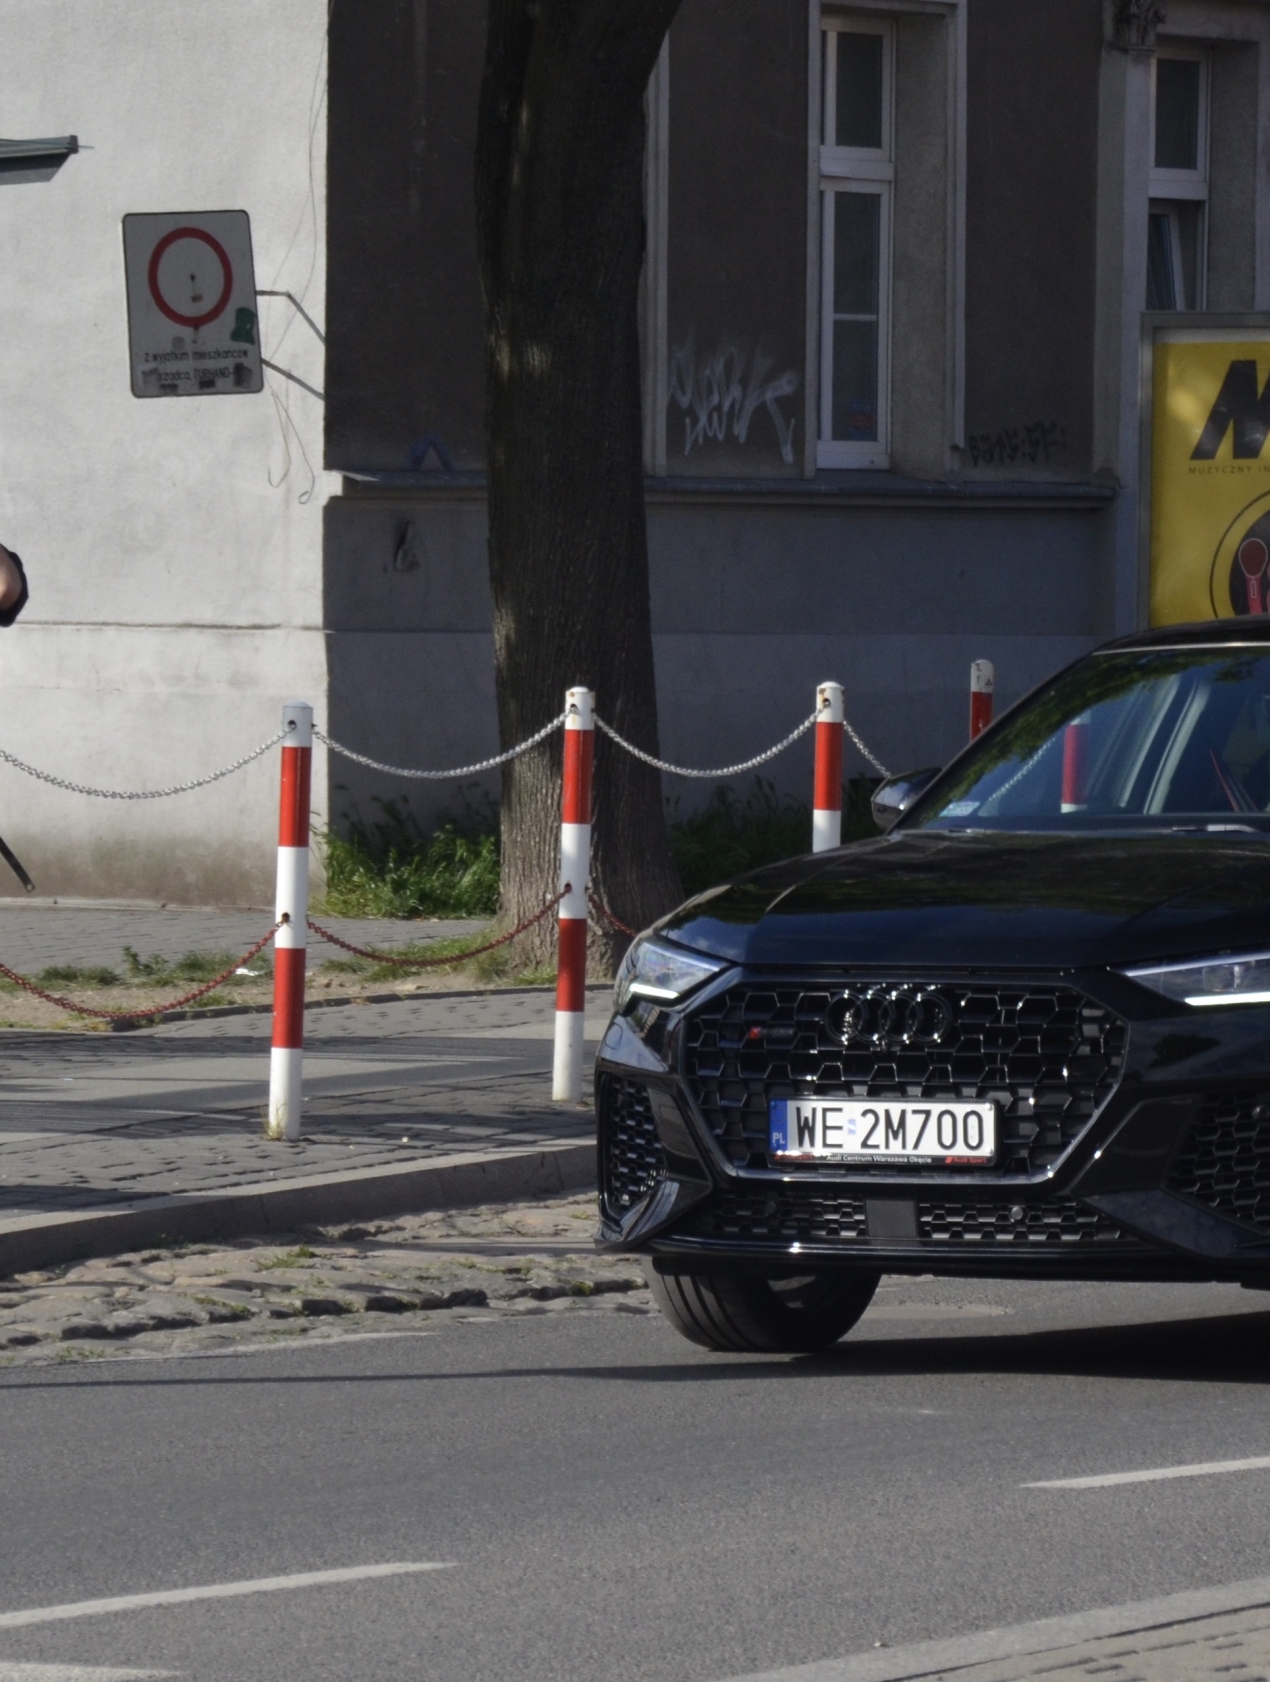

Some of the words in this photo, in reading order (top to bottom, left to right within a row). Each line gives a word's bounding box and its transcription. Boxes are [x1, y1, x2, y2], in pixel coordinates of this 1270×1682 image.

[1189, 465, 1252, 475] MUZYCZNY
[796, 1107, 844, 1149] WE
[860, 1108, 985, 1151] 2M700
[772, 1132, 785, 1145] PL
[843, 1154, 871, 1162] Centrum
[873, 1155, 908, 1163] Warszawa
